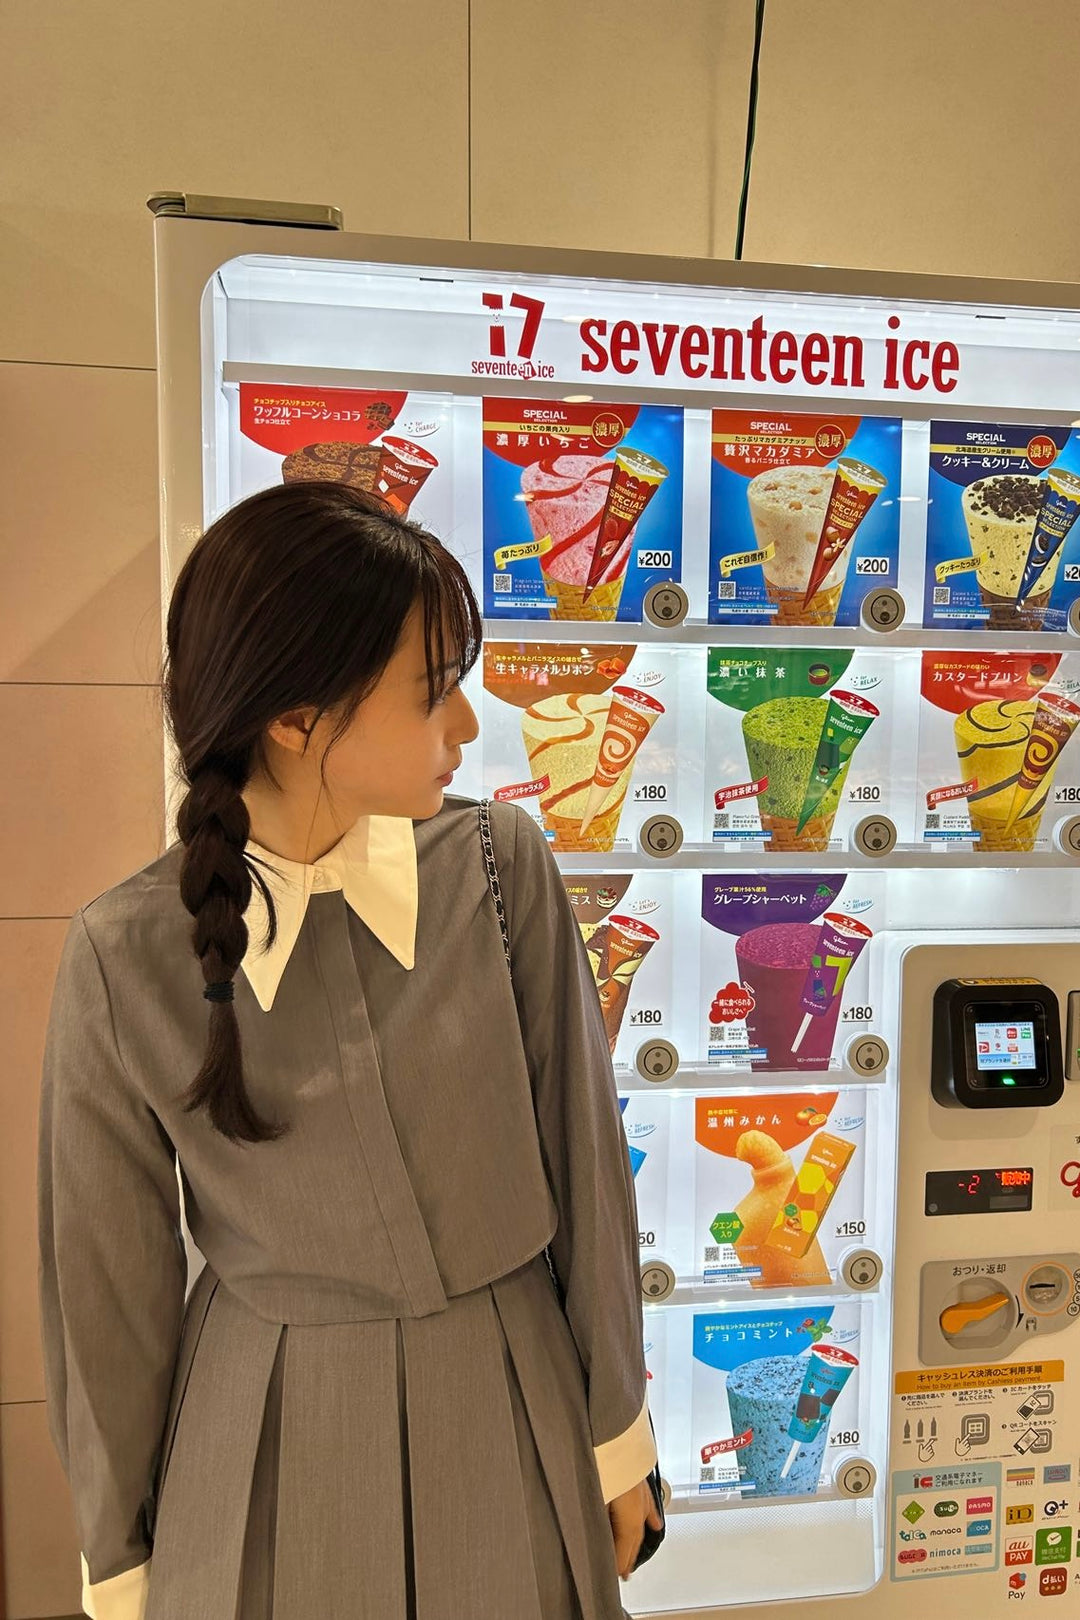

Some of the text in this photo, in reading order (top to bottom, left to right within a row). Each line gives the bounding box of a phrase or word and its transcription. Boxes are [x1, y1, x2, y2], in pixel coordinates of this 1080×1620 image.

[579, 315, 960, 393] seventeen ice
[471, 360, 555, 379] seventeen ice
[253, 406, 362, 421] ワッフルコーンショコラ
[523, 409, 567, 420] SPECIAL
[519, 424, 571, 433] いちごの果肉入り
[595, 421, 621, 438] 濃厚
[750, 421, 792, 431] SPECIAL
[734, 435, 808, 444] たっぷりマカダミアナッツ
[817, 434, 842, 448] 濃厚
[966, 432, 1006, 442] SPECIAL
[724, 444, 816, 459] 贅沢マカダミア
[1030, 444, 1053, 458] 濃厚
[744, 456, 791, 465] 香るバニラ仕立て
[941, 455, 1030, 470] クッキー&クリーム
[609, 489, 644, 510] SPECIAL
[830, 498, 864, 519] SPECIAL
[1040, 507, 1071, 527] SPECIAL
[501, 543, 540, 559] 苺たっぷり
[638, 552, 671, 567] ¥200
[857, 558, 888, 574] ¥200
[939, 556, 981, 574] クッキーたっぷり
[495, 663, 594, 676] 生キャラメルリボン
[719, 666, 786, 678] 濃い抹茶
[933, 671, 1023, 683] カスタードプリン
[498, 782, 544, 801] たっぷりキャラメル
[634, 785, 666, 799] ¥180
[718, 785, 759, 801] 宇治抹茶使用
[849, 786, 880, 800] ¥180
[714, 894, 807, 905] グレープシャーベット
[631, 1010, 662, 1023] ¥180
[842, 1007, 873, 1020] ¥180
[707, 1114, 782, 1128] 温州みかん
[712, 1221, 740, 1230] クエン酸
[836, 1221, 866, 1235] ¥150
[720, 1230, 733, 1239] 入り
[952, 1264, 1006, 1276] おつり・返却
[704, 1327, 793, 1344] チョコミント
[917, 1365, 1043, 1382] キャッシュレス決済のご利用手順
[830, 1431, 860, 1445] ¥180
[1009, 1540, 1030, 1550] au
[929, 1547, 962, 1558] nimoca
[1009, 1552, 1029, 1561] PAY
[1008, 1591, 1026, 1600] Pay
